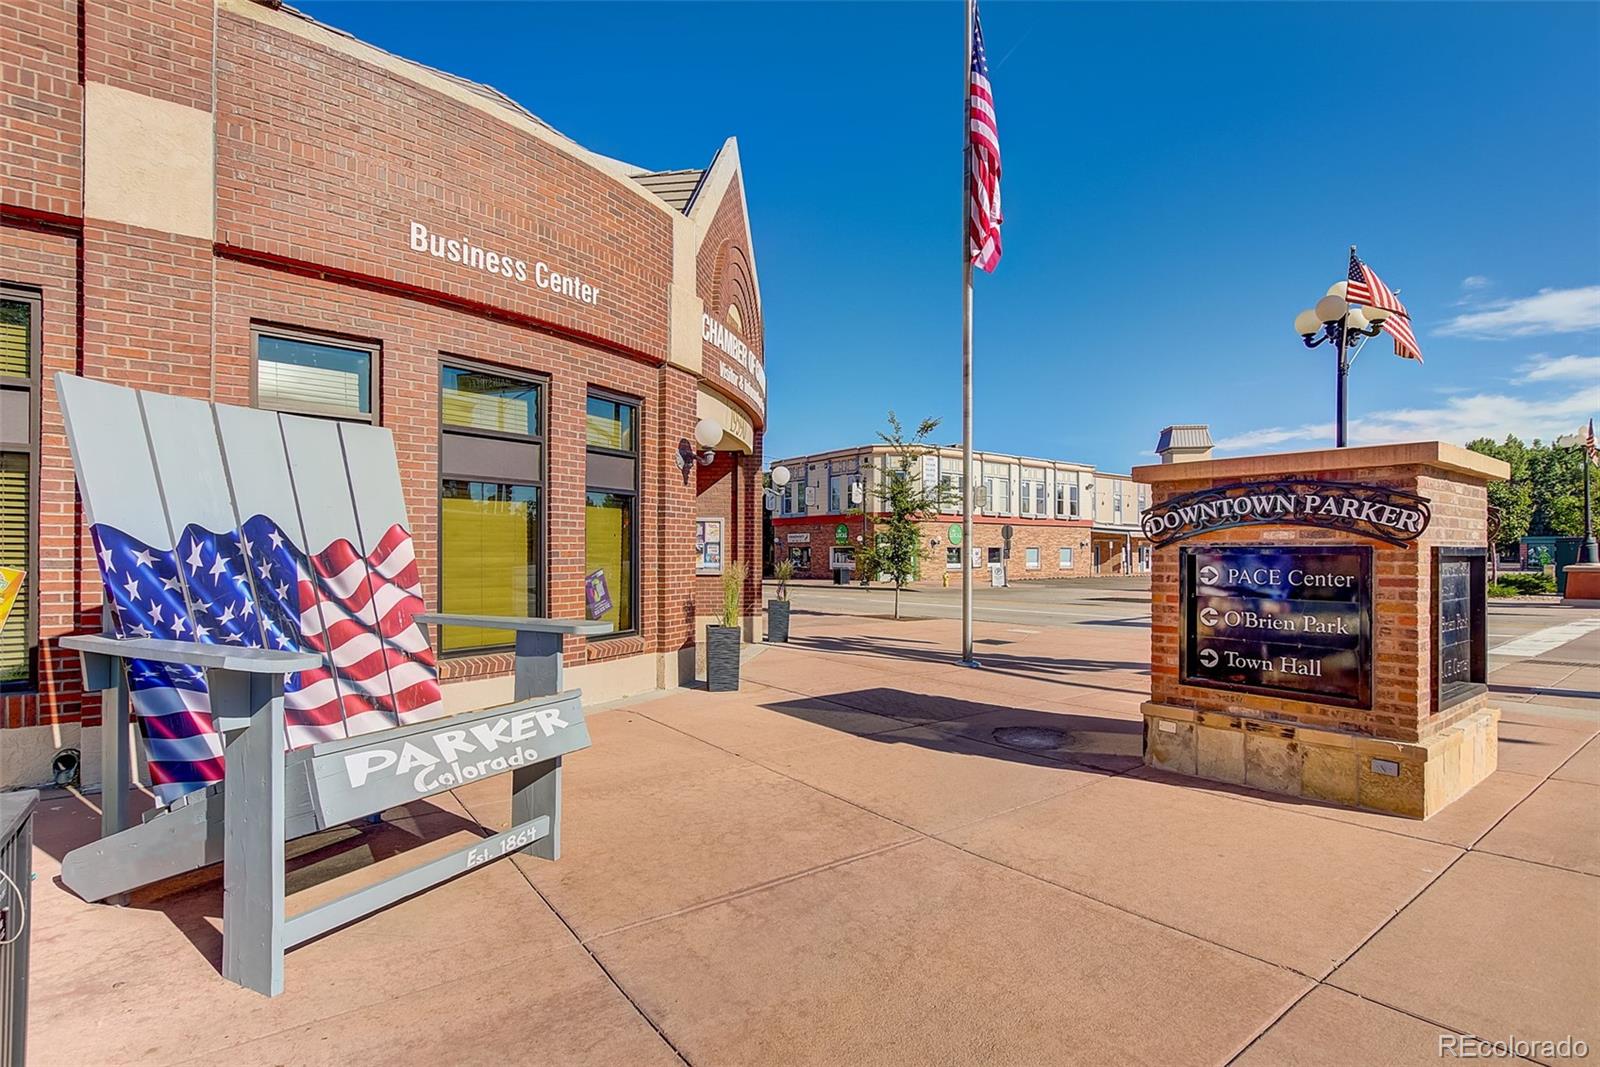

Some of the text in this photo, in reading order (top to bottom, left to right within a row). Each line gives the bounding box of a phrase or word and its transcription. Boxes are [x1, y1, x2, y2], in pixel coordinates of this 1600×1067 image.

[409, 221, 600, 306] Business Center
[702, 313, 748, 369] CHAMBER
[1149, 494, 1418, 535] DOWNTOWN PARKER
[1227, 569, 1355, 588] PACE Center
[1223, 609, 1351, 635] O'Brien Park
[1223, 650, 1322, 677] Town Hall
[344, 707, 569, 789] PARKER
[413, 746, 538, 793] Colorado
[465, 825, 537, 868] Est. 1864
